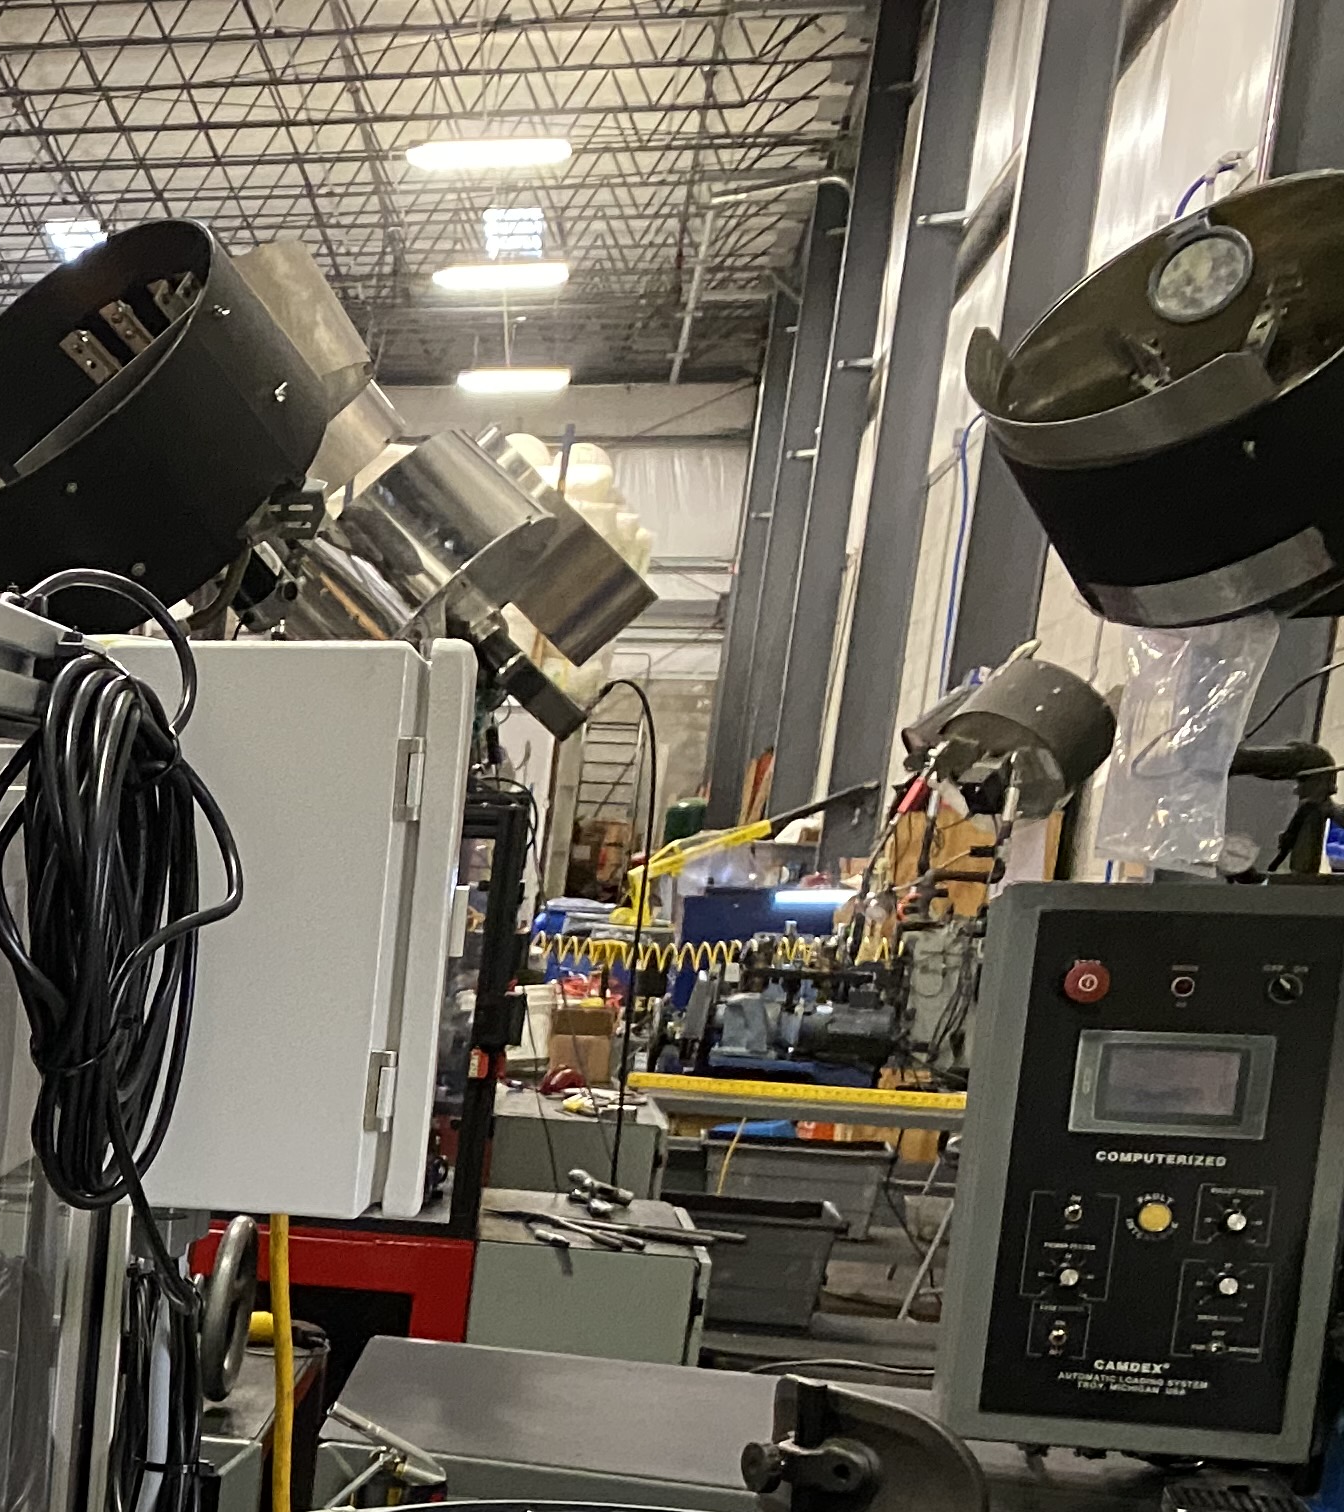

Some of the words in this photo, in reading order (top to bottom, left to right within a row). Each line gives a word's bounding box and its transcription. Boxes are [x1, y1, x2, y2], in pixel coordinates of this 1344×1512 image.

[1095, 1150, 1227, 1168] COMPUTERIZED
[1058, 1371, 1117, 1385] AUTOMATIC
[1167, 1379, 1209, 1390] SYSTEM
